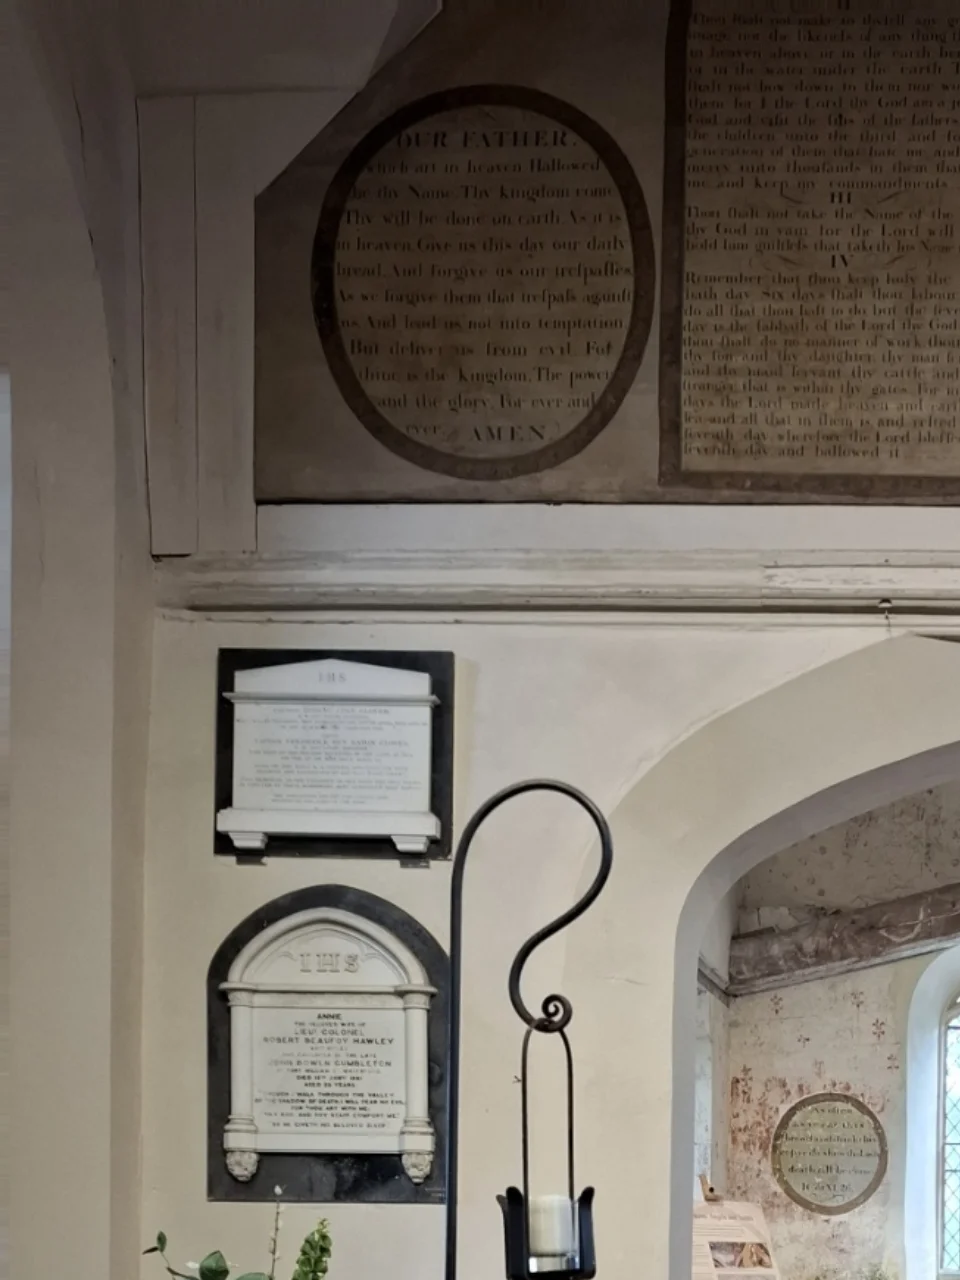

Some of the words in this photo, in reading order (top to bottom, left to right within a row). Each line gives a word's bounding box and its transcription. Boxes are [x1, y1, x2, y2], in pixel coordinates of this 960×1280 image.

[396, 130, 448, 148] OUR
[461, 185, 492, 199] Thy
[500, 185, 570, 202] kingdom
[830, 192, 852, 204] III
[345, 211, 372, 225] Thy
[831, 255, 854, 268] IV
[351, 340, 379, 356] But
[487, 340, 527, 356] from
[299, 952, 359, 973] IHS
